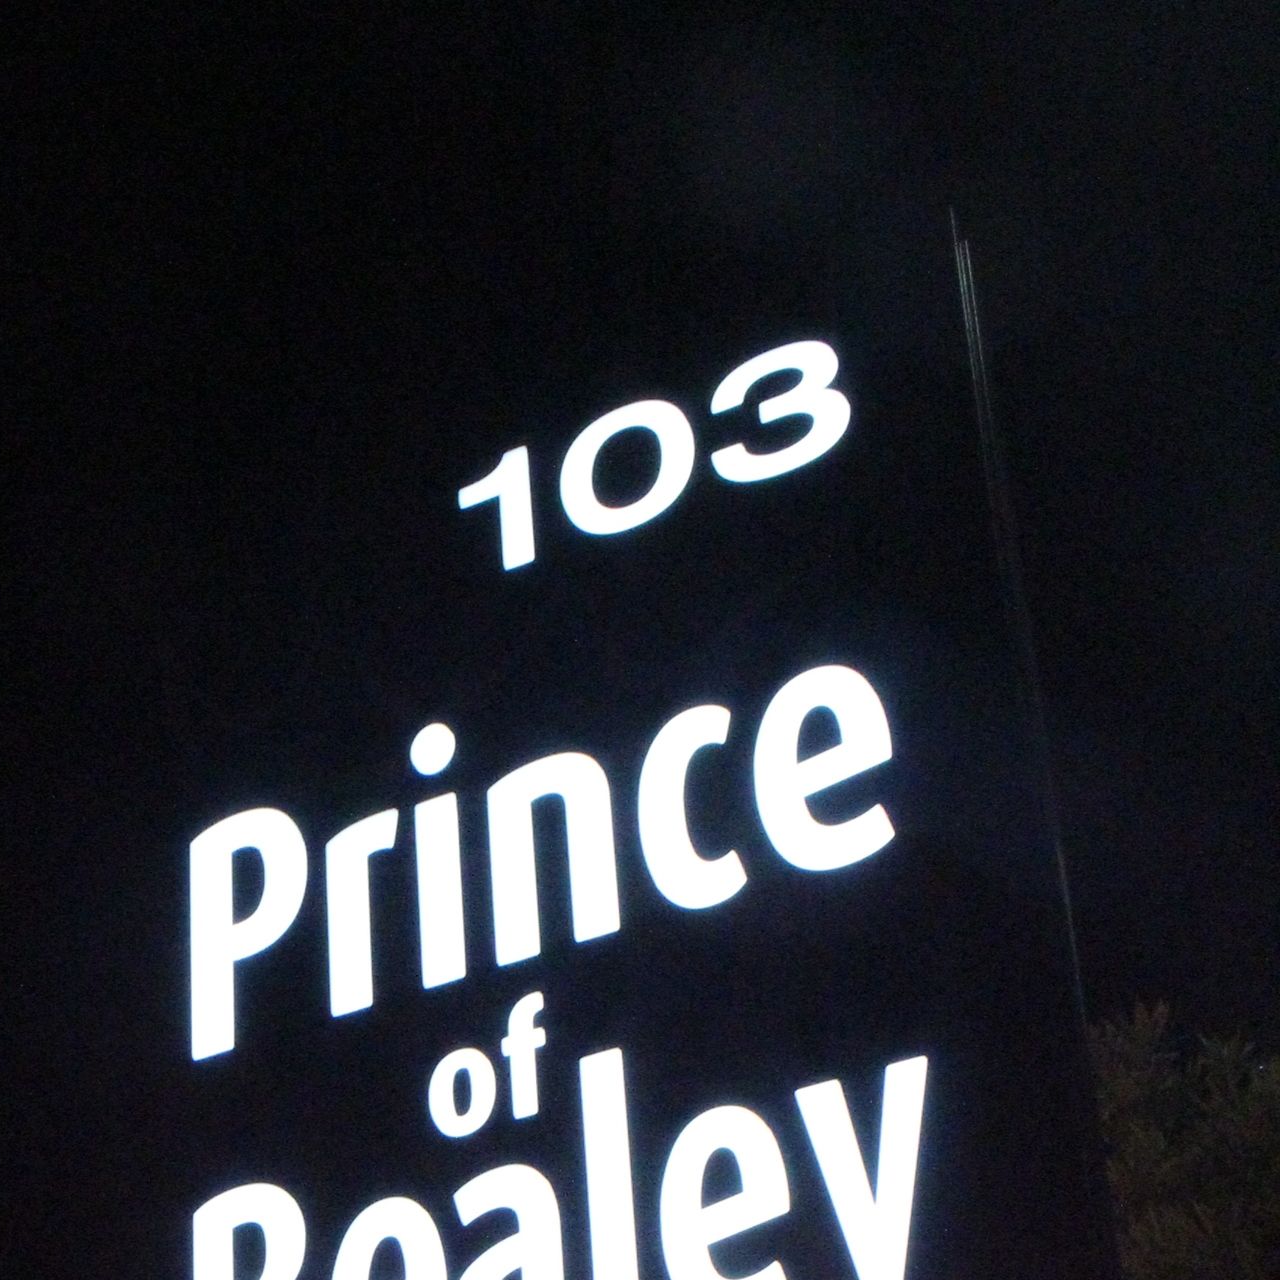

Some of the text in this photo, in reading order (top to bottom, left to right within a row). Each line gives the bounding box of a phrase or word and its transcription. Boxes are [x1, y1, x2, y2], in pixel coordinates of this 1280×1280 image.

[458, 340, 852, 570] 103
[188, 664, 896, 1061] Prince
[428, 990, 547, 1138] of
